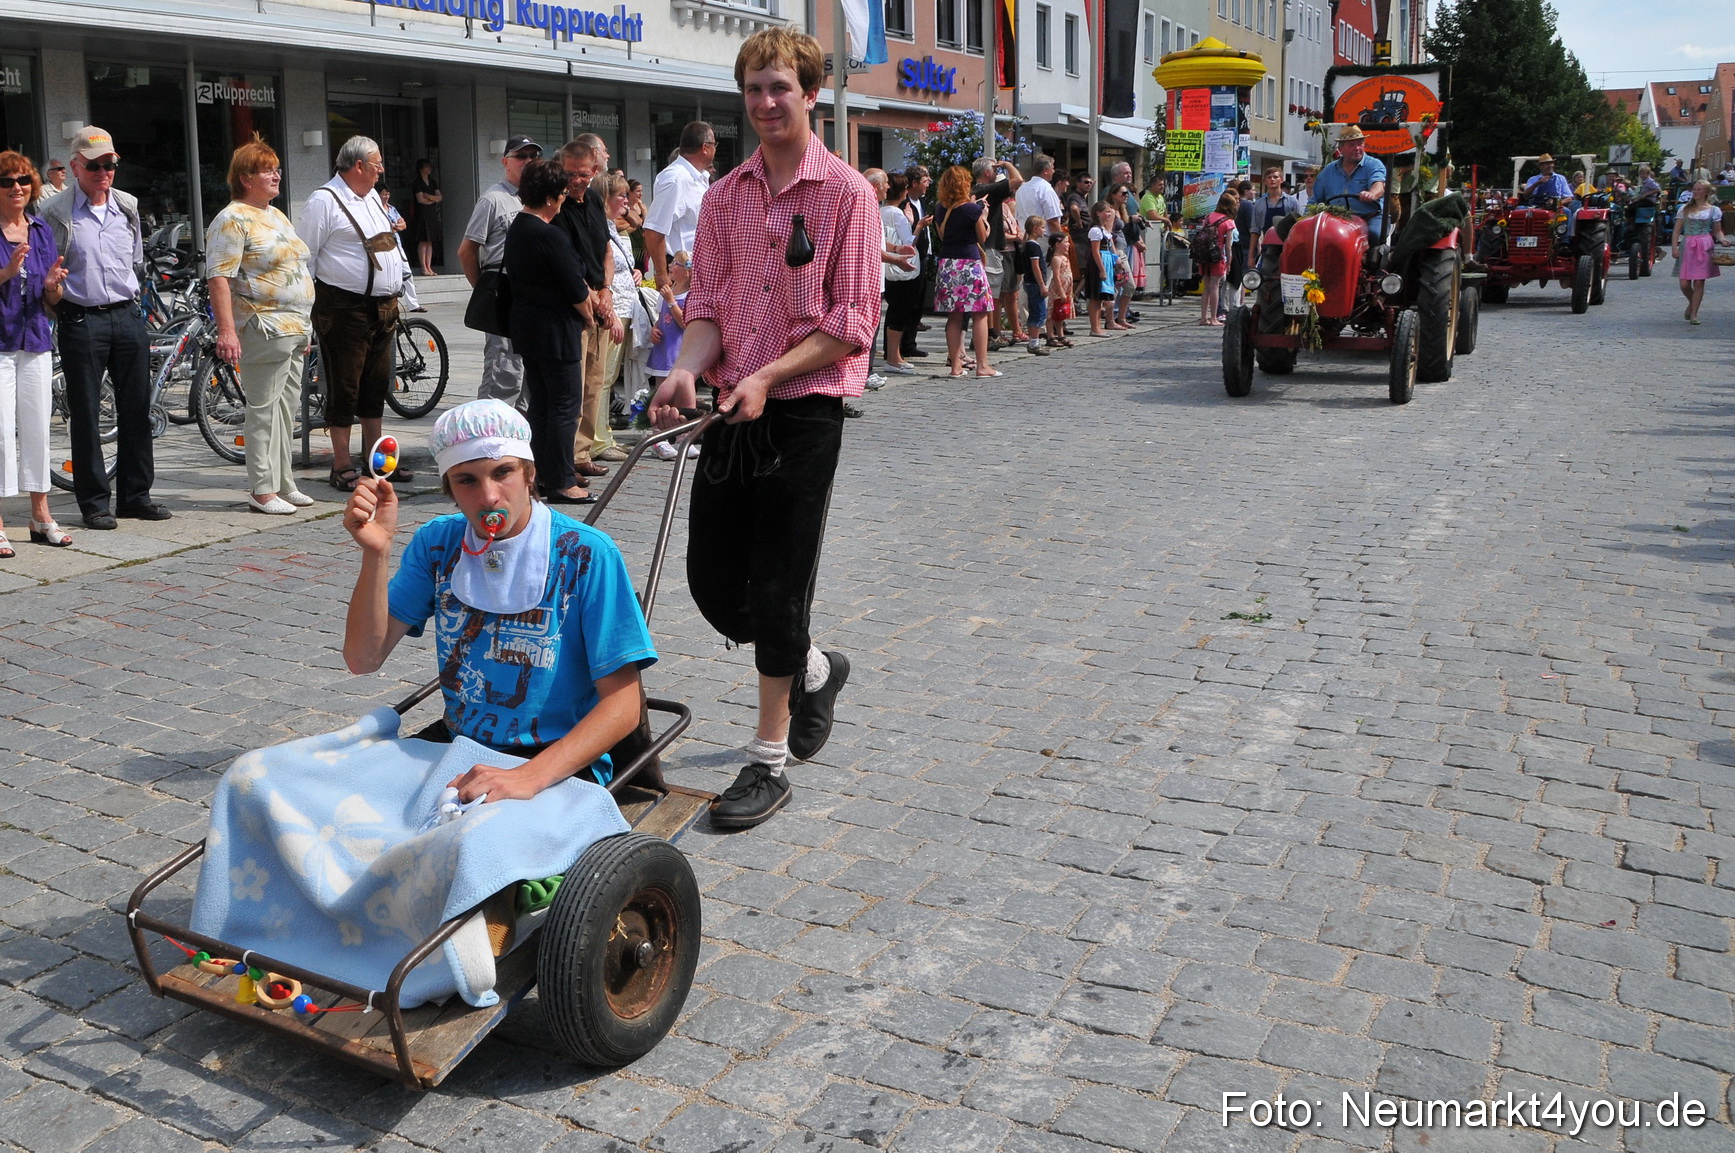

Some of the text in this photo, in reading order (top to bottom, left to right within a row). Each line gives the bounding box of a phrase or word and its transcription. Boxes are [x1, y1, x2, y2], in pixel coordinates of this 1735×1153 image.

[511, 0, 643, 42] Rupprecht
[214, 82, 276, 106] Rupprecht
[582, 110, 619, 128] Rupprecht
[1188, 131, 1202, 139] Club
